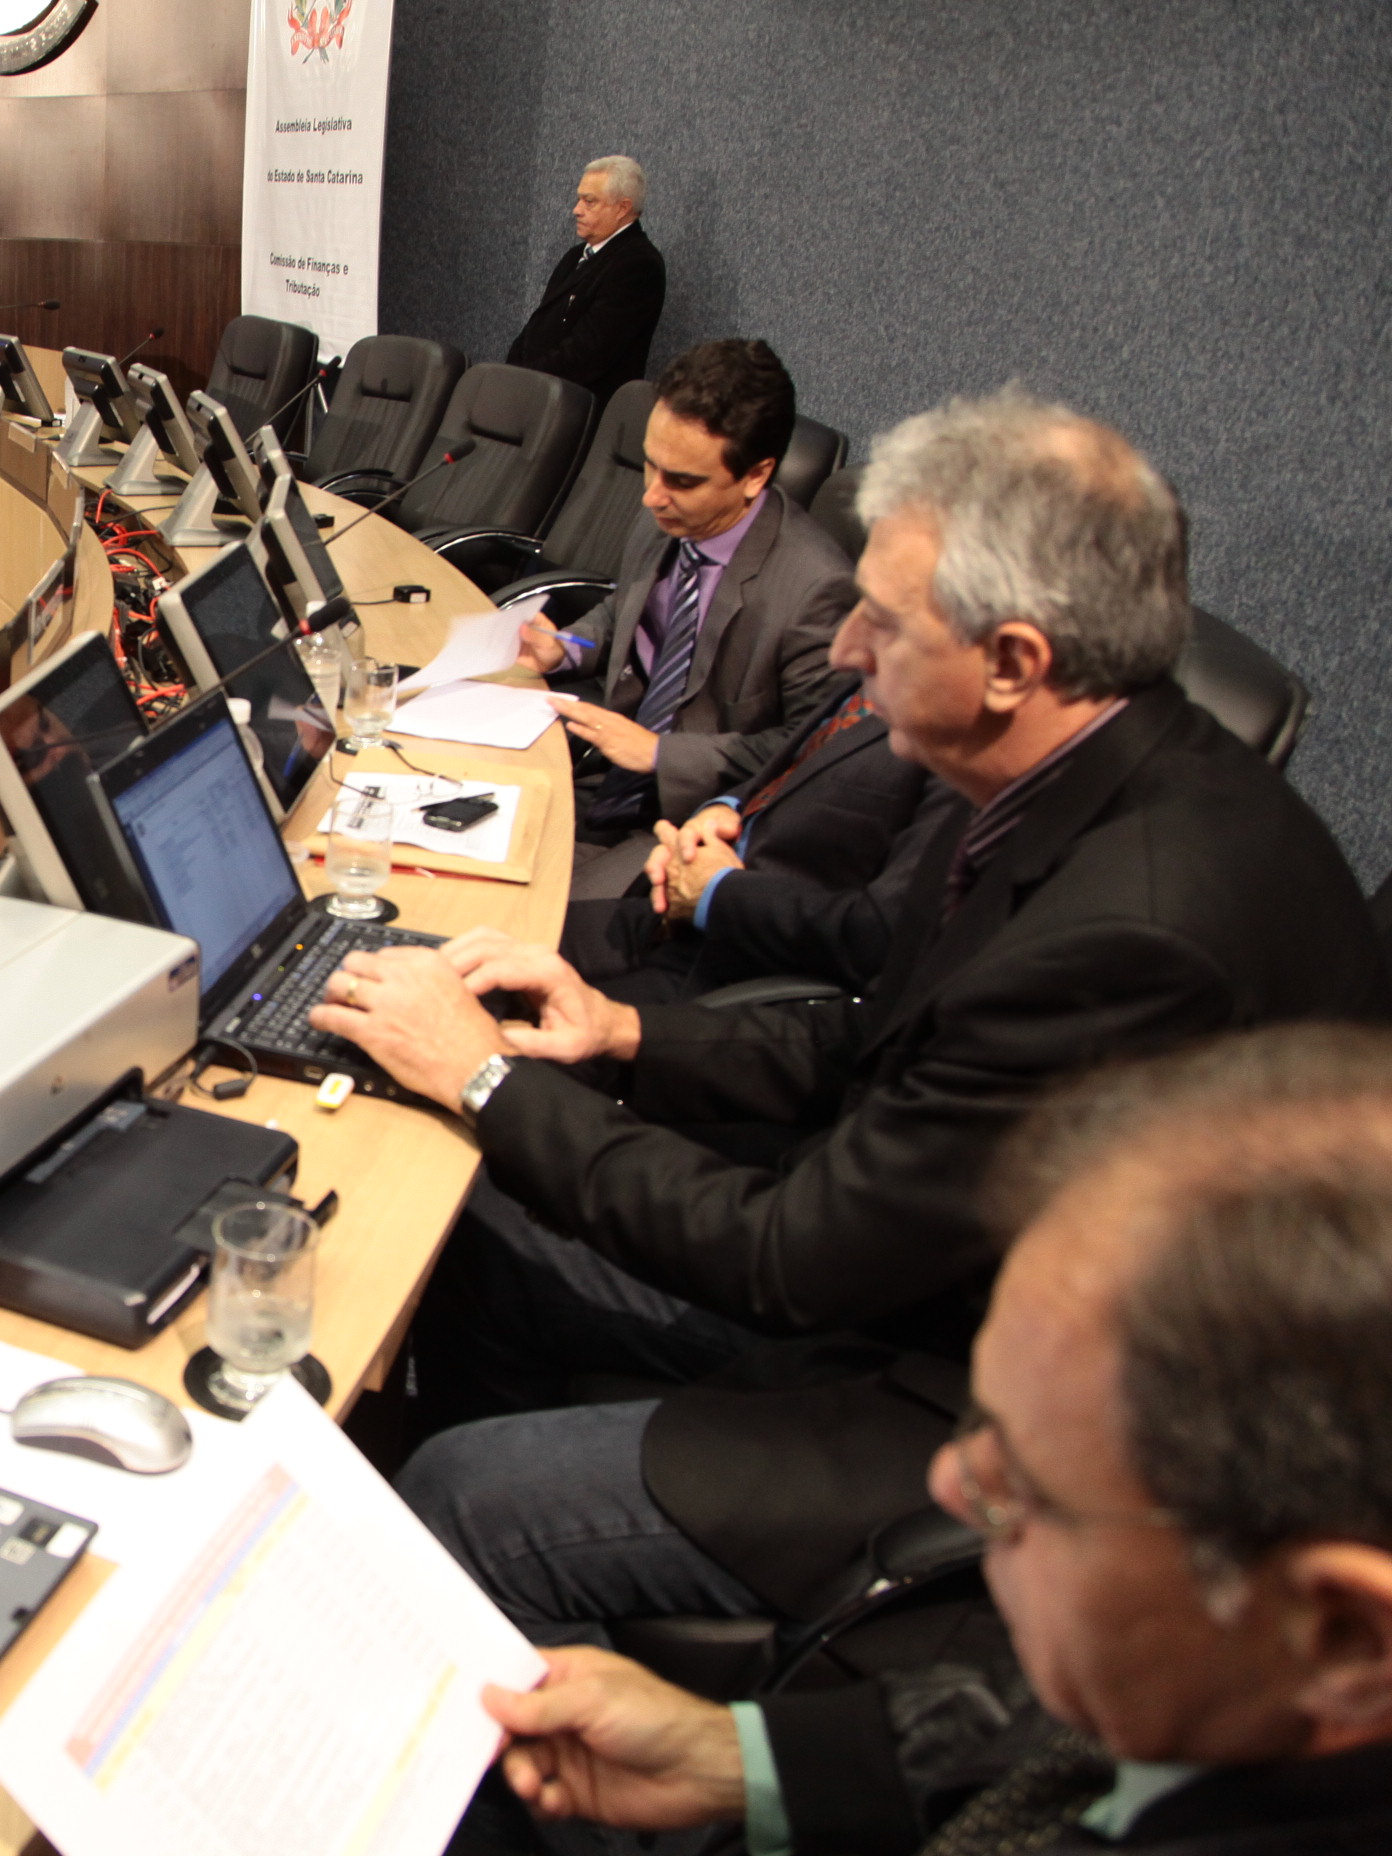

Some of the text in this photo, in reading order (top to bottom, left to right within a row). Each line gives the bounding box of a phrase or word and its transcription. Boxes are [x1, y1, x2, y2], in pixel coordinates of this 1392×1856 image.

[275, 117, 352, 135] Assembleia Legislativa
[274, 169, 295, 182] Estado
[297, 170, 304, 183] de
[306, 169, 325, 183] Santa
[327, 170, 363, 184] Catarina
[298, 256, 306, 270] de
[307, 257, 340, 276] Finanças
[343, 264, 349, 275] e
[286, 279, 321, 299] Tributação
